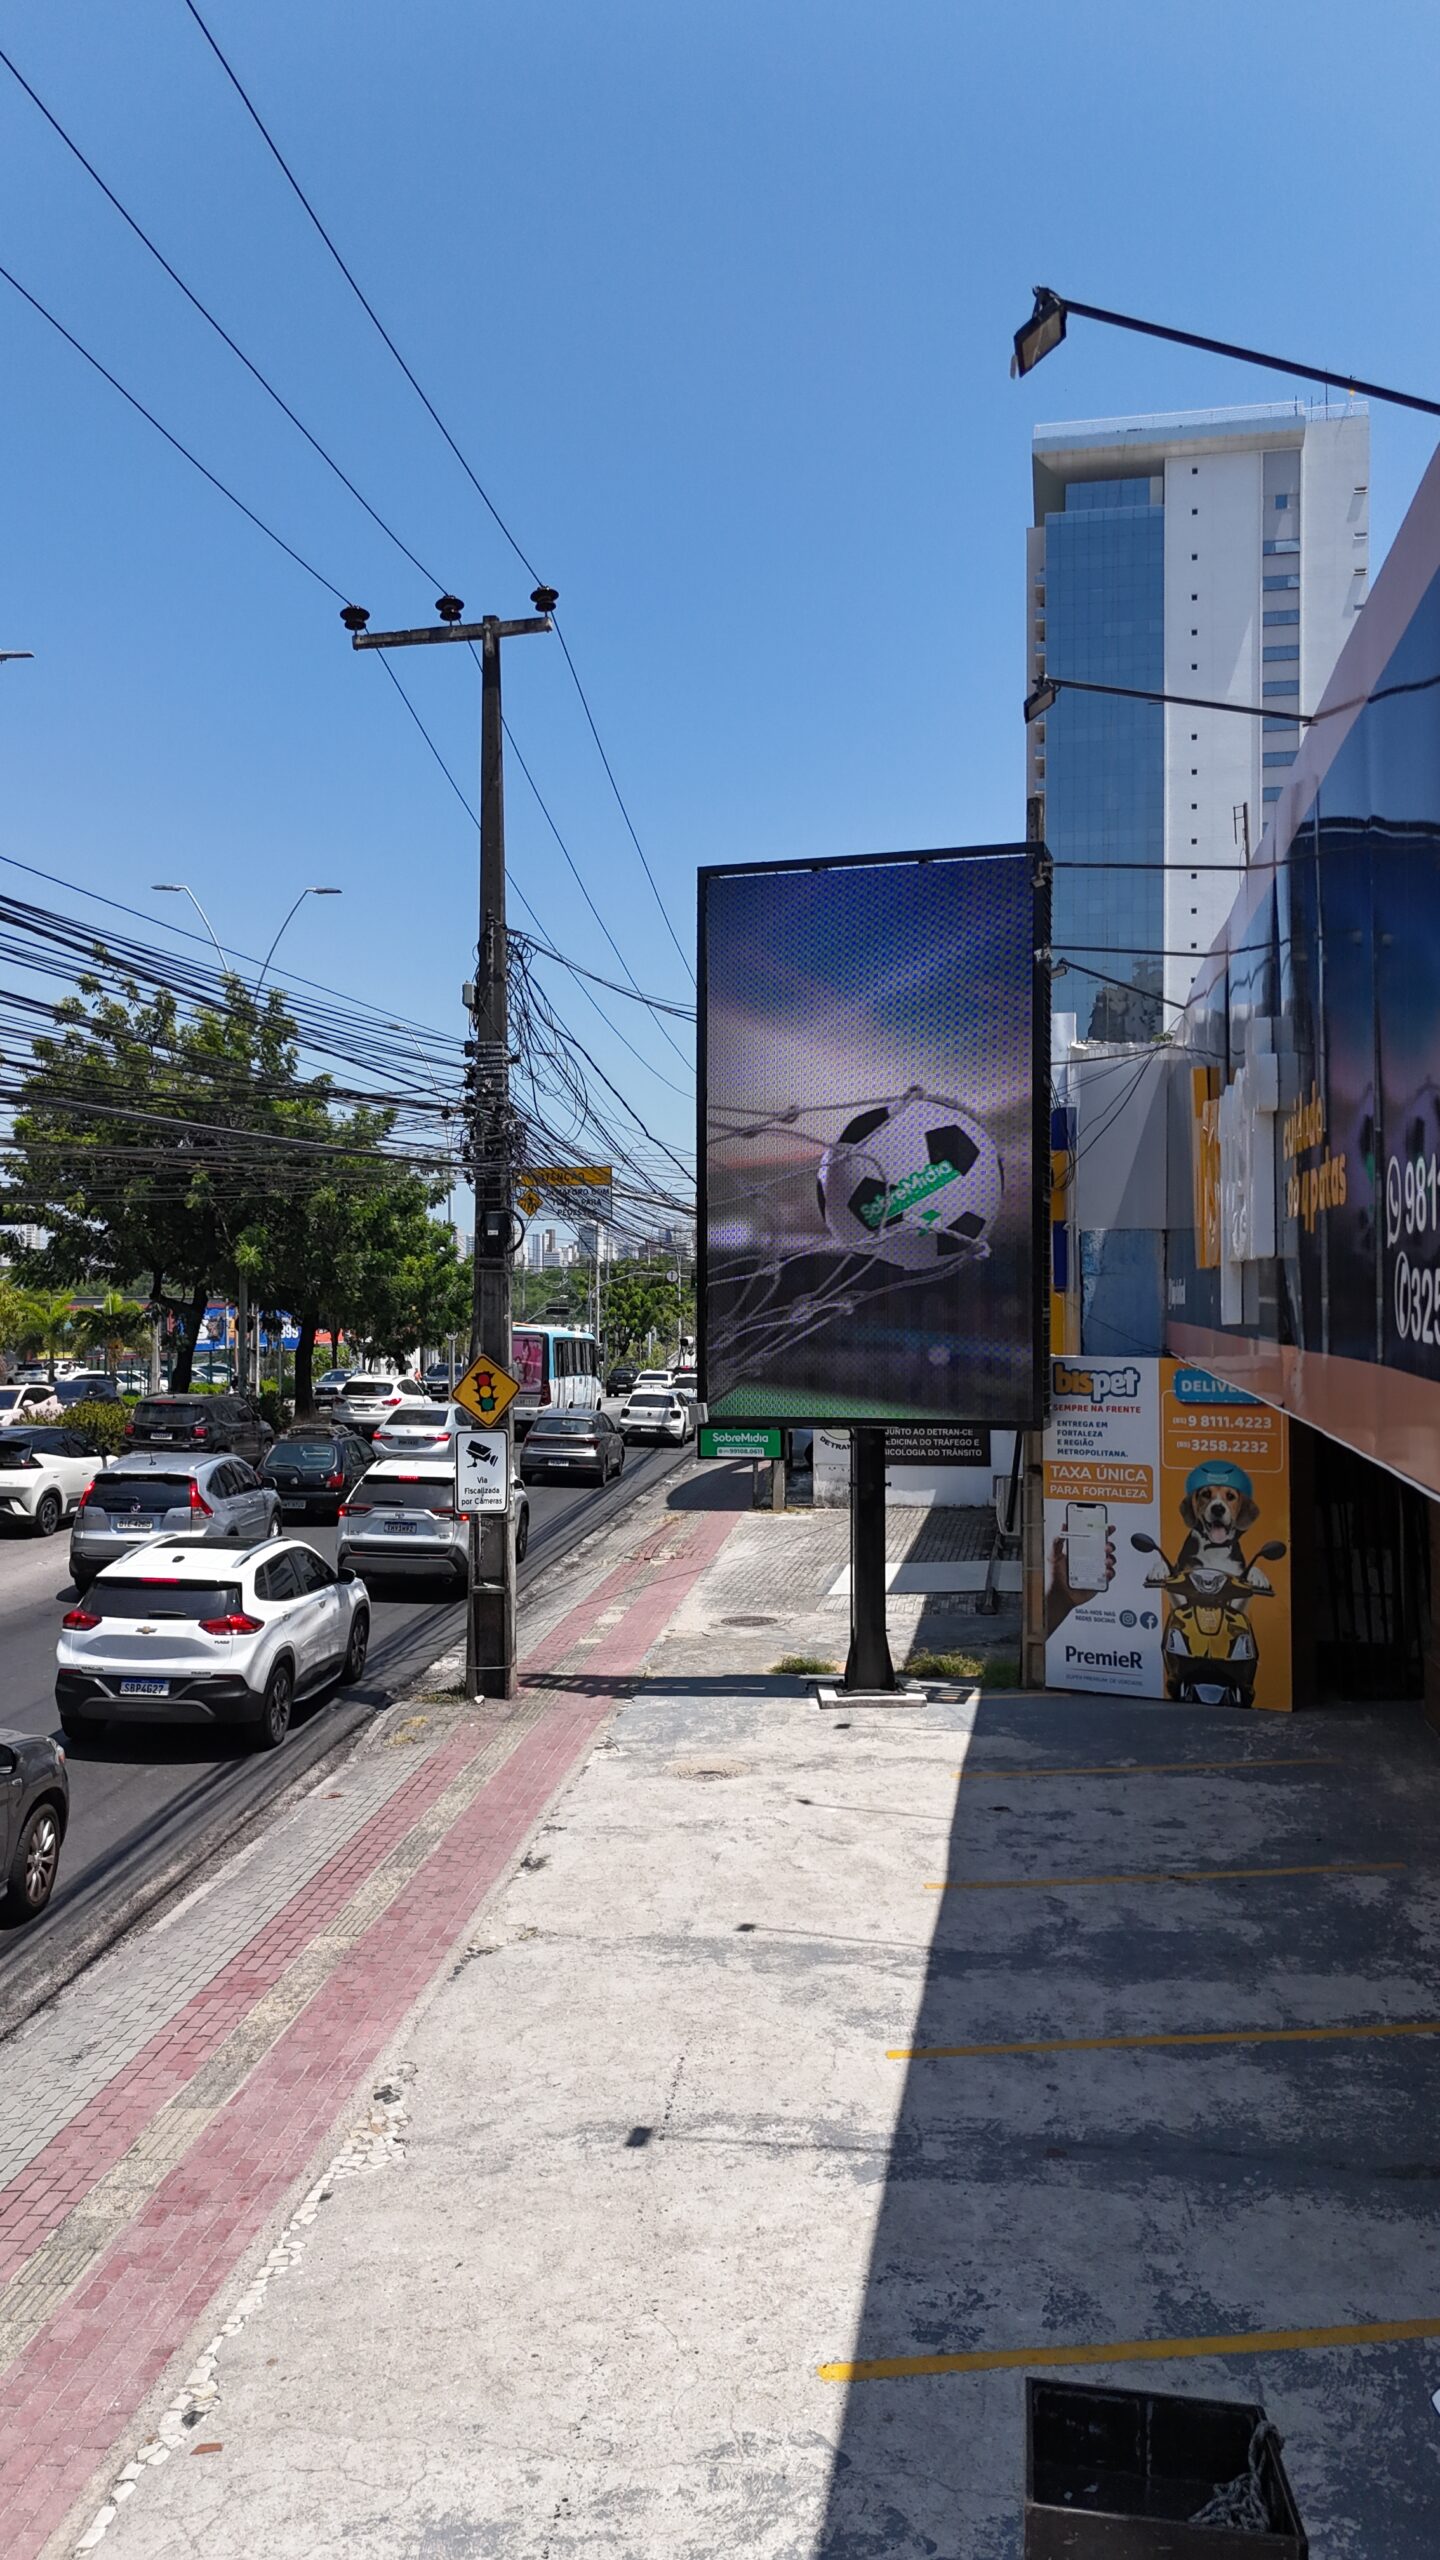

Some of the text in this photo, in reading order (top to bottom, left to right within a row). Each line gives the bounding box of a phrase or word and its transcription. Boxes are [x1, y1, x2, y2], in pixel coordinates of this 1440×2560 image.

[1310, 1146, 1347, 1234] patas
[1405, 1153, 1440, 1235] 981
[1053, 1361, 1140, 1403] bispet
[1181, 1380, 1240, 1392] DELIVE
[1052, 1404, 1088, 1412] SEMPRE
[1106, 1405, 1141, 1414] FRENTE
[1057, 1420, 1094, 1428] ENTREGA
[1187, 1415, 1197, 1427] 9
[1200, 1416, 1272, 1429] 8111.4223
[885, 1428, 974, 1436] JUNTO AO DETRAN-CE
[1057, 1430, 1103, 1438] FORTALEZA
[933, 1437, 972, 1447] TRÁFEGO
[1063, 1438, 1094, 1446] REGIÃO
[1191, 1439, 1268, 1453] 3258.2232
[942, 1447, 982, 1457] TRÂNSITO
[1057, 1448, 1129, 1458] METROPOLITANA.
[1050, 1464, 1148, 1482] TAXA ÚNICA
[477, 1476, 488, 1484] Via
[464, 1487, 500, 1495] Fiscalizada
[1049, 1485, 1148, 1498] PARA FORTALEZA
[461, 1498, 472, 1506] por
[1065, 1645, 1144, 1670] PremieR
